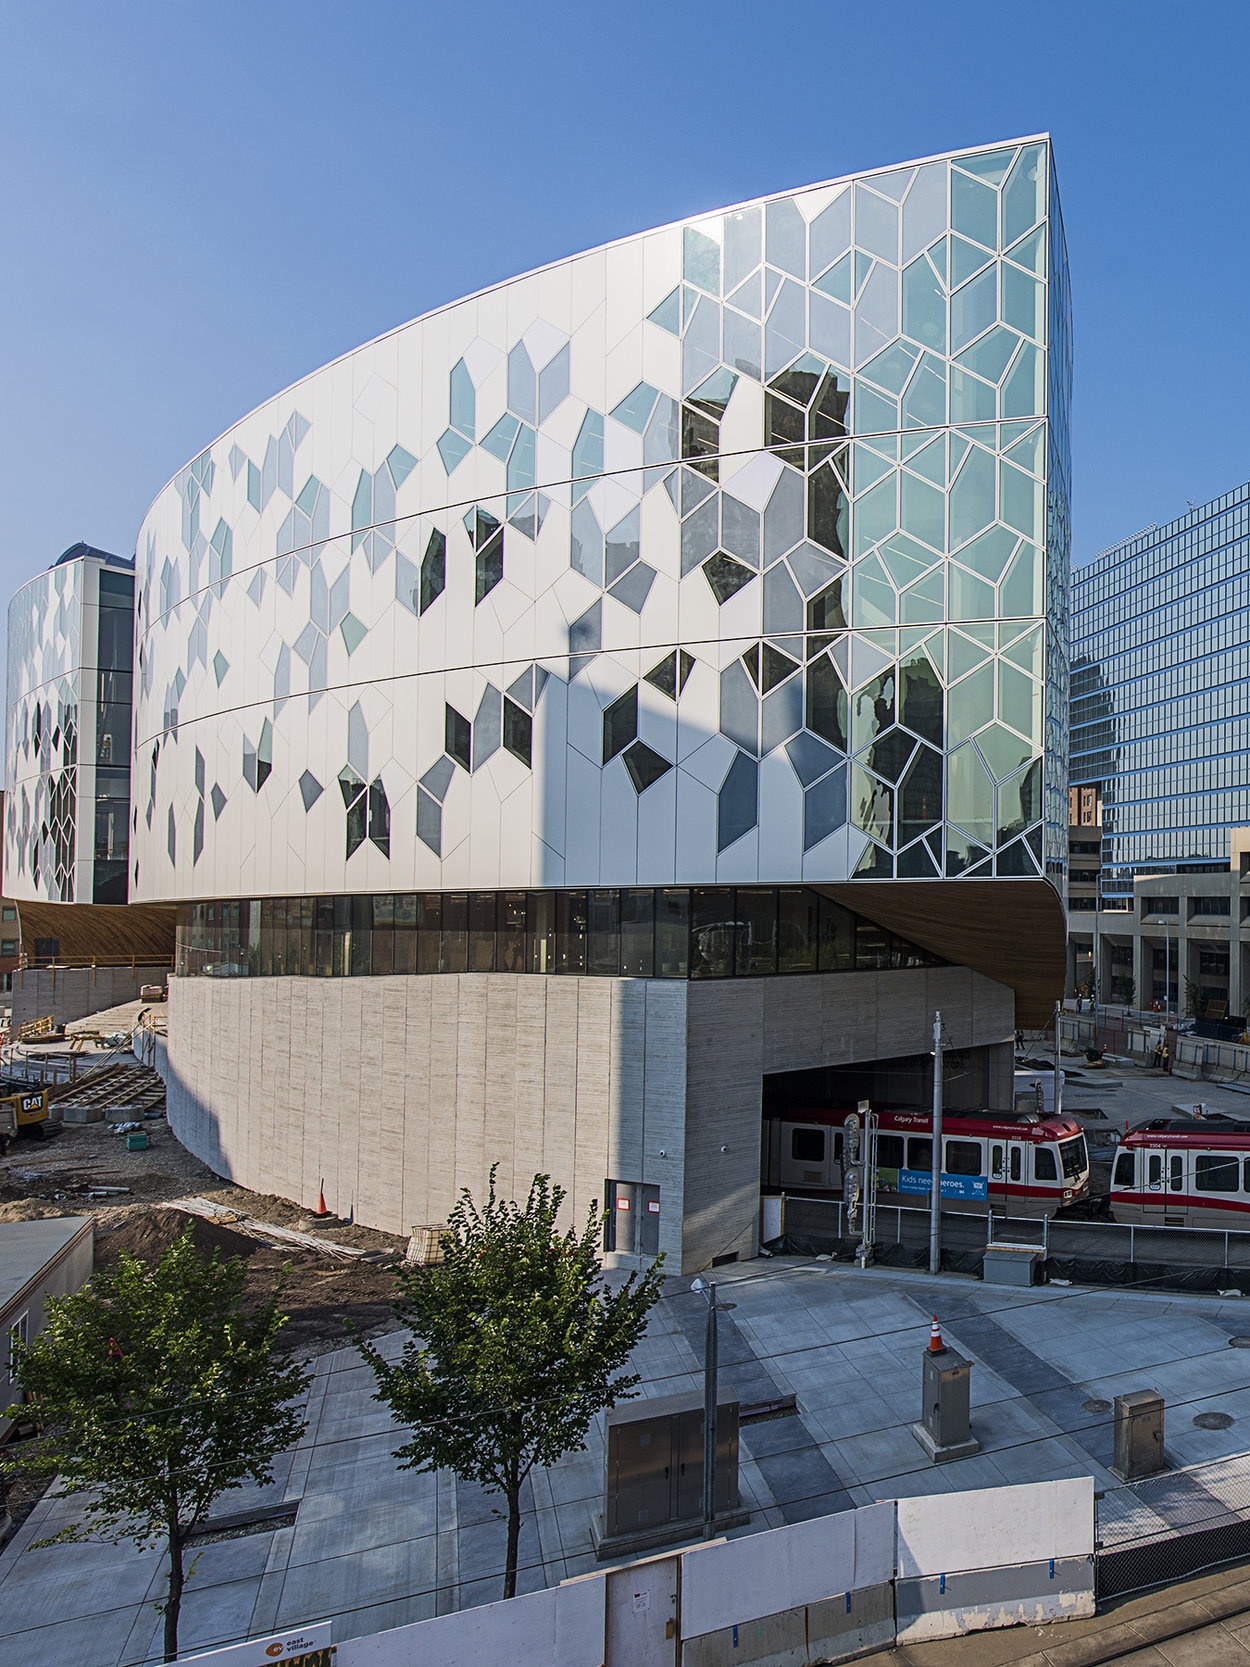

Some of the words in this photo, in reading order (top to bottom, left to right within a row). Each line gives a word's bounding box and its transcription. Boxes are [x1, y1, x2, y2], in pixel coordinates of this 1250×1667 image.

[23, 1096, 42, 1110] CAT
[894, 1115, 912, 1124] Calgary
[913, 1116, 929, 1124] Transit
[901, 1174, 917, 1184] Kids
[287, 1637, 304, 1646] east
[287, 1641, 314, 1652] village
